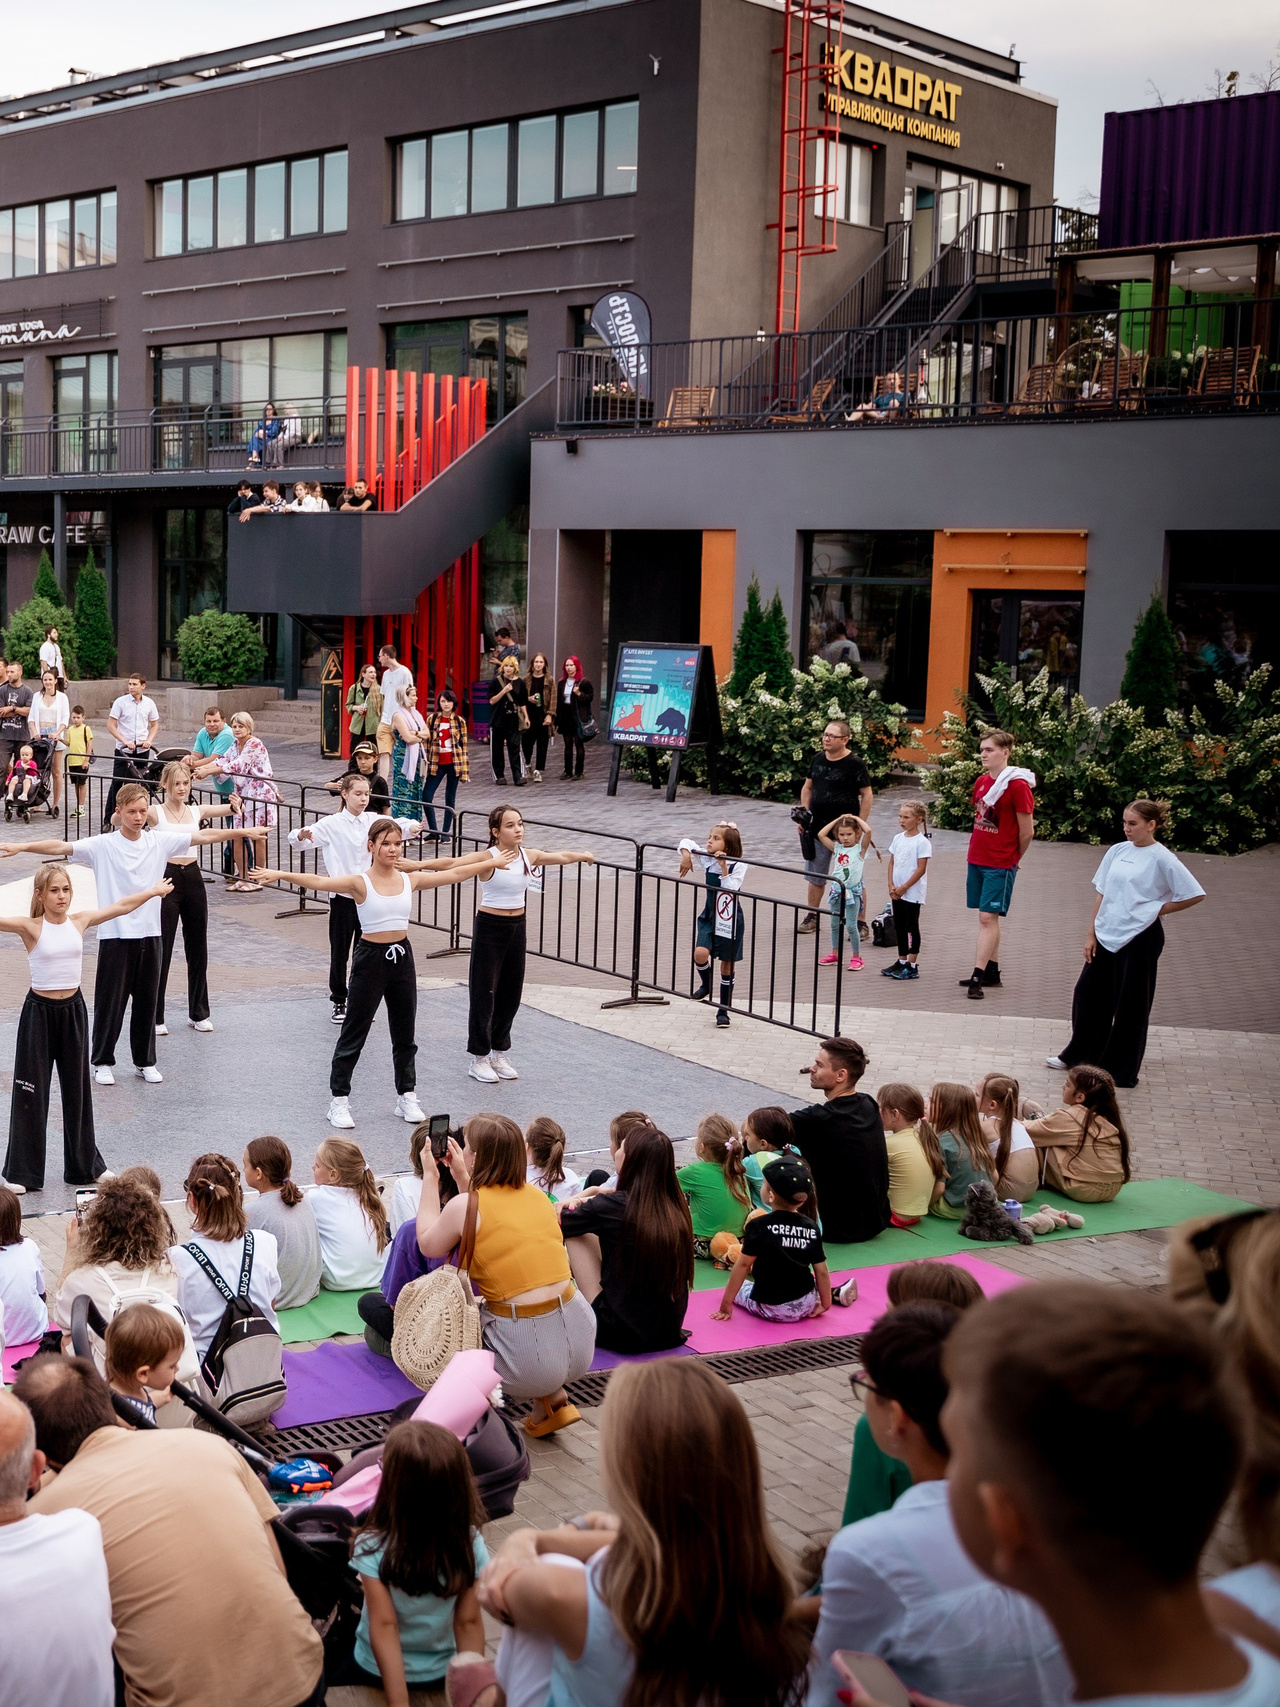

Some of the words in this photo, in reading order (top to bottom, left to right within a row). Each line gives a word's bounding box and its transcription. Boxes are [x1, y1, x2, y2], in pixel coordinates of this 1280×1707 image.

[824, 91, 905, 132] УПРАВЛЯЮЩАЯ
[907, 117, 961, 149] КОМПАНИЯ
[19, 319, 45, 332] YOGA
[38, 525, 87, 544] CFE
[205, 1264, 217, 1278] SPORT
